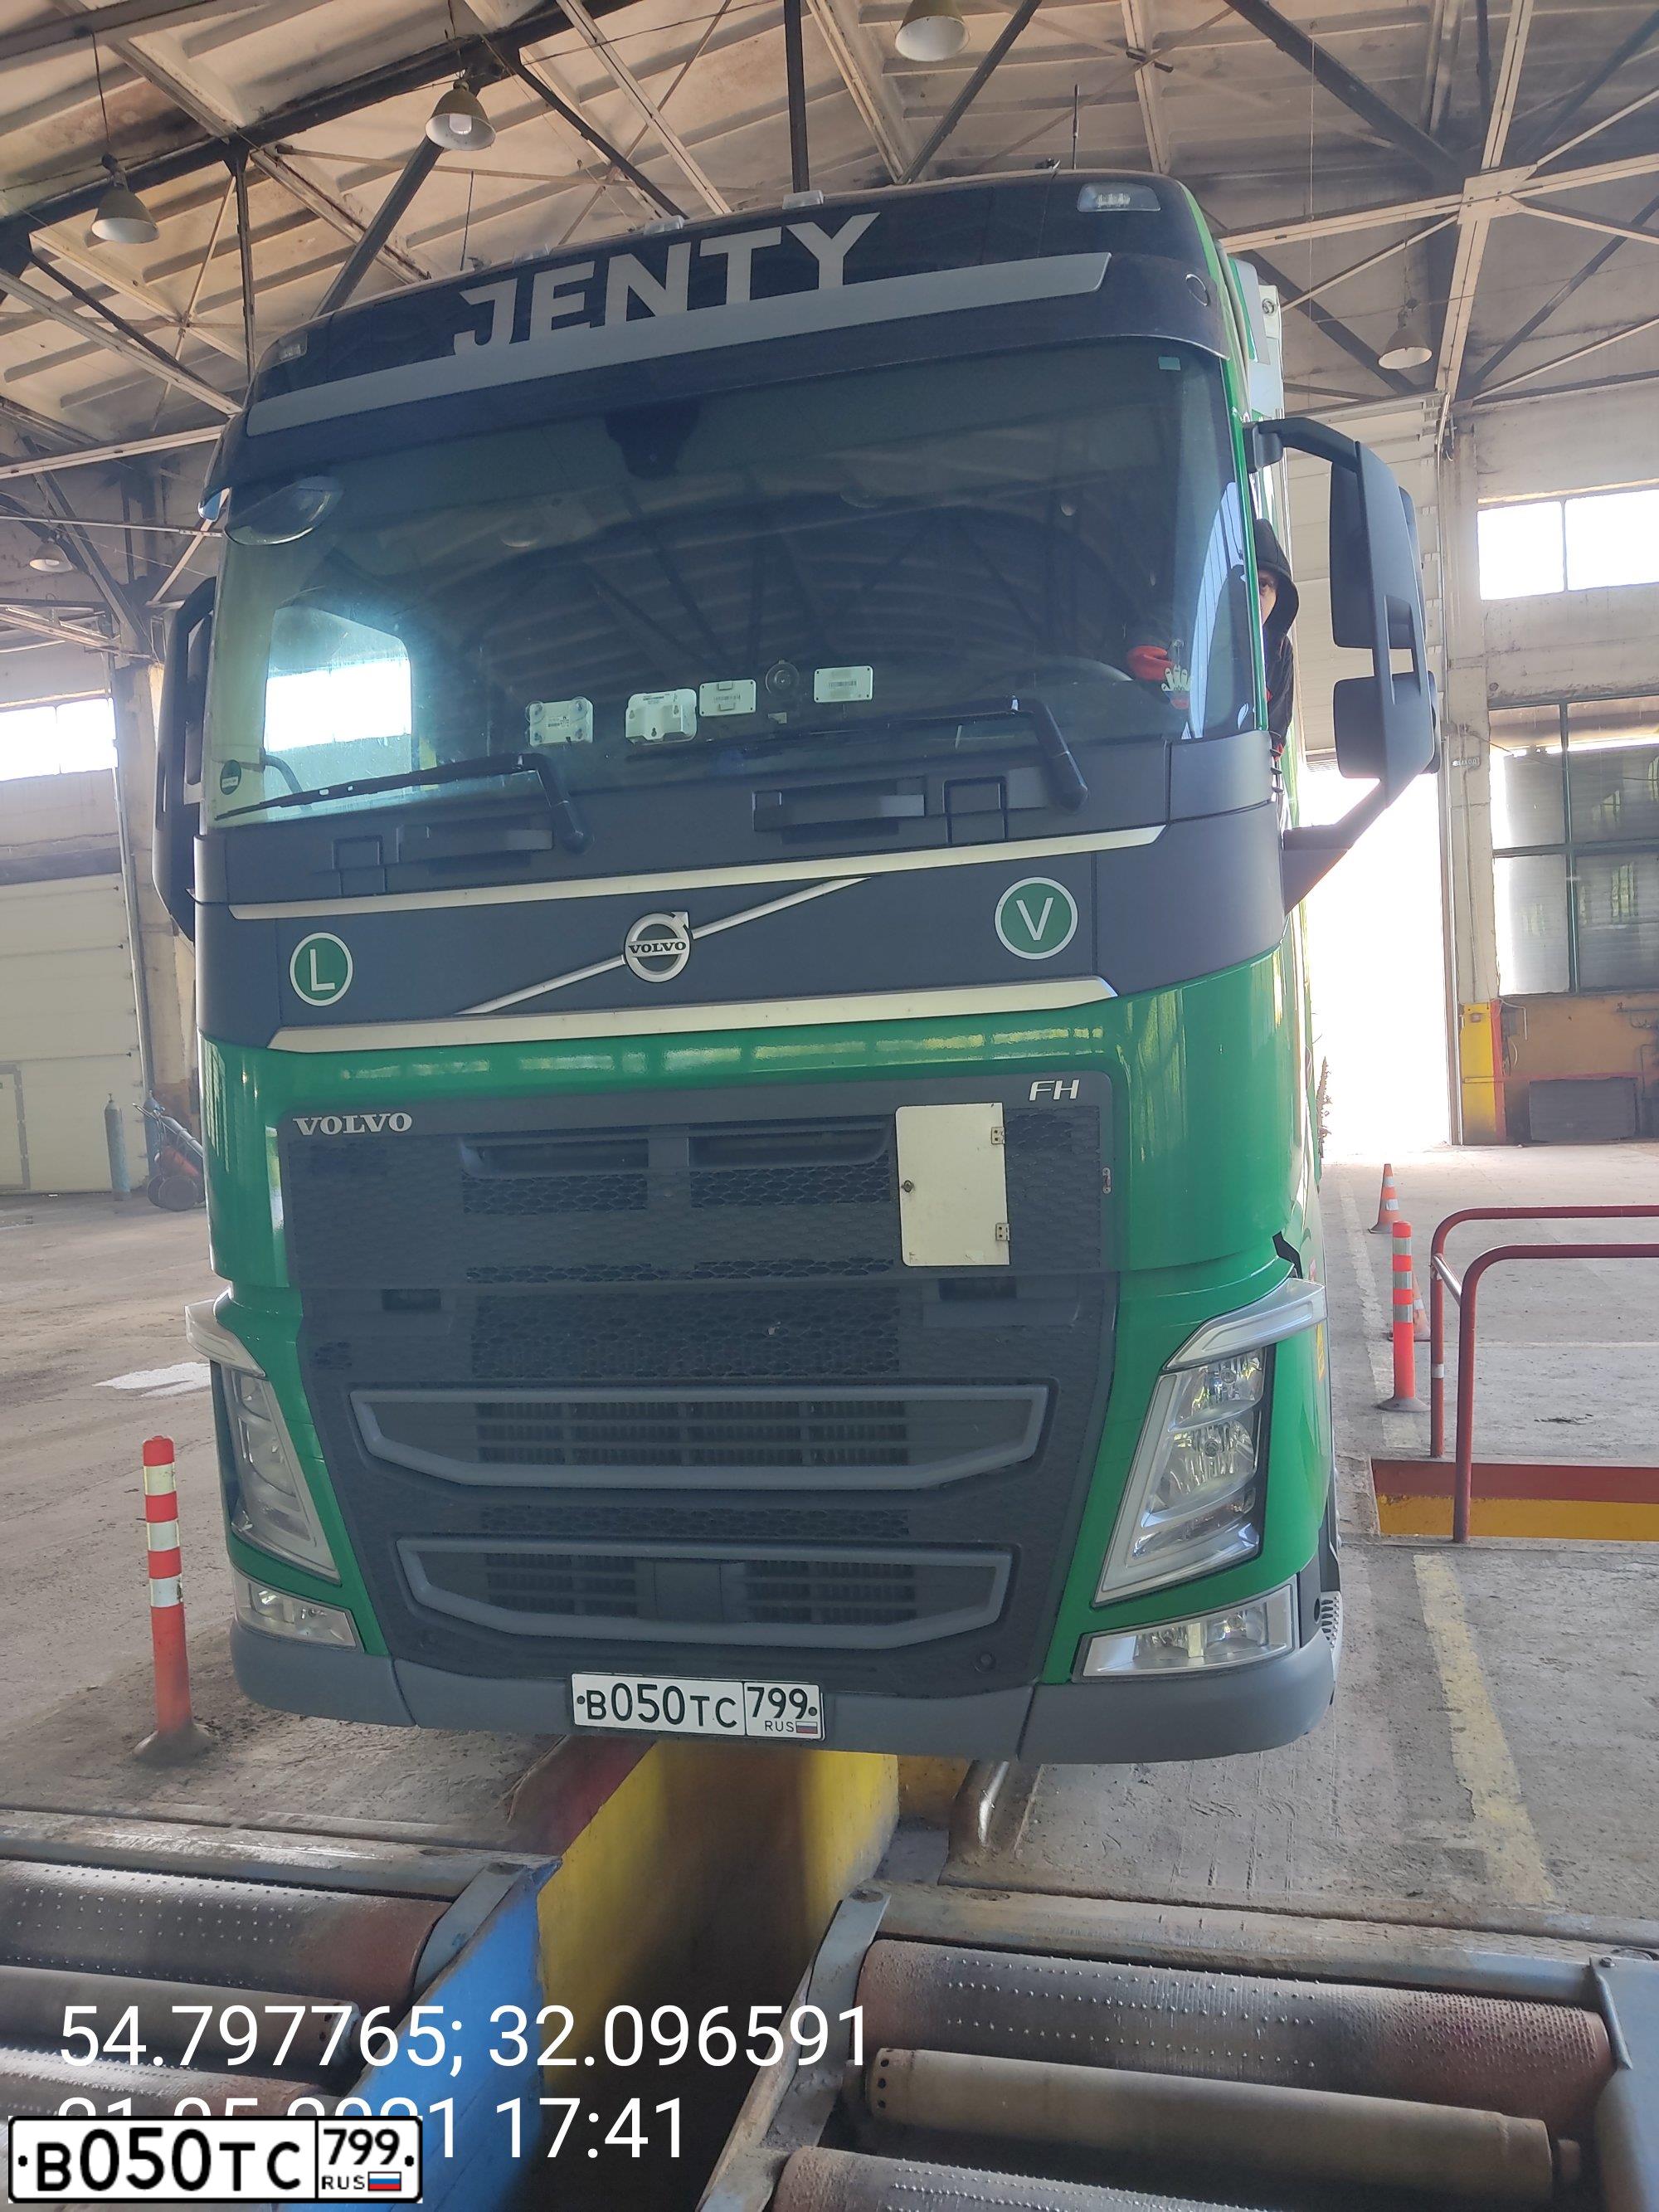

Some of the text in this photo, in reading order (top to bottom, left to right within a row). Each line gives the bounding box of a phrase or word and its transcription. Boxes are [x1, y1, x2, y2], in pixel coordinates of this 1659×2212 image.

[454, 212, 881, 355] JENTY
[1015, 897, 1054, 941] V
[628, 941, 687, 954] VOLVO
[309, 948, 336, 992] L
[1029, 1079, 1080, 1101] FH
[292, 1112, 413, 1136] VOLVO
[747, 1686, 808, 1719] 799
[765, 1719, 795, 1732] RUS
